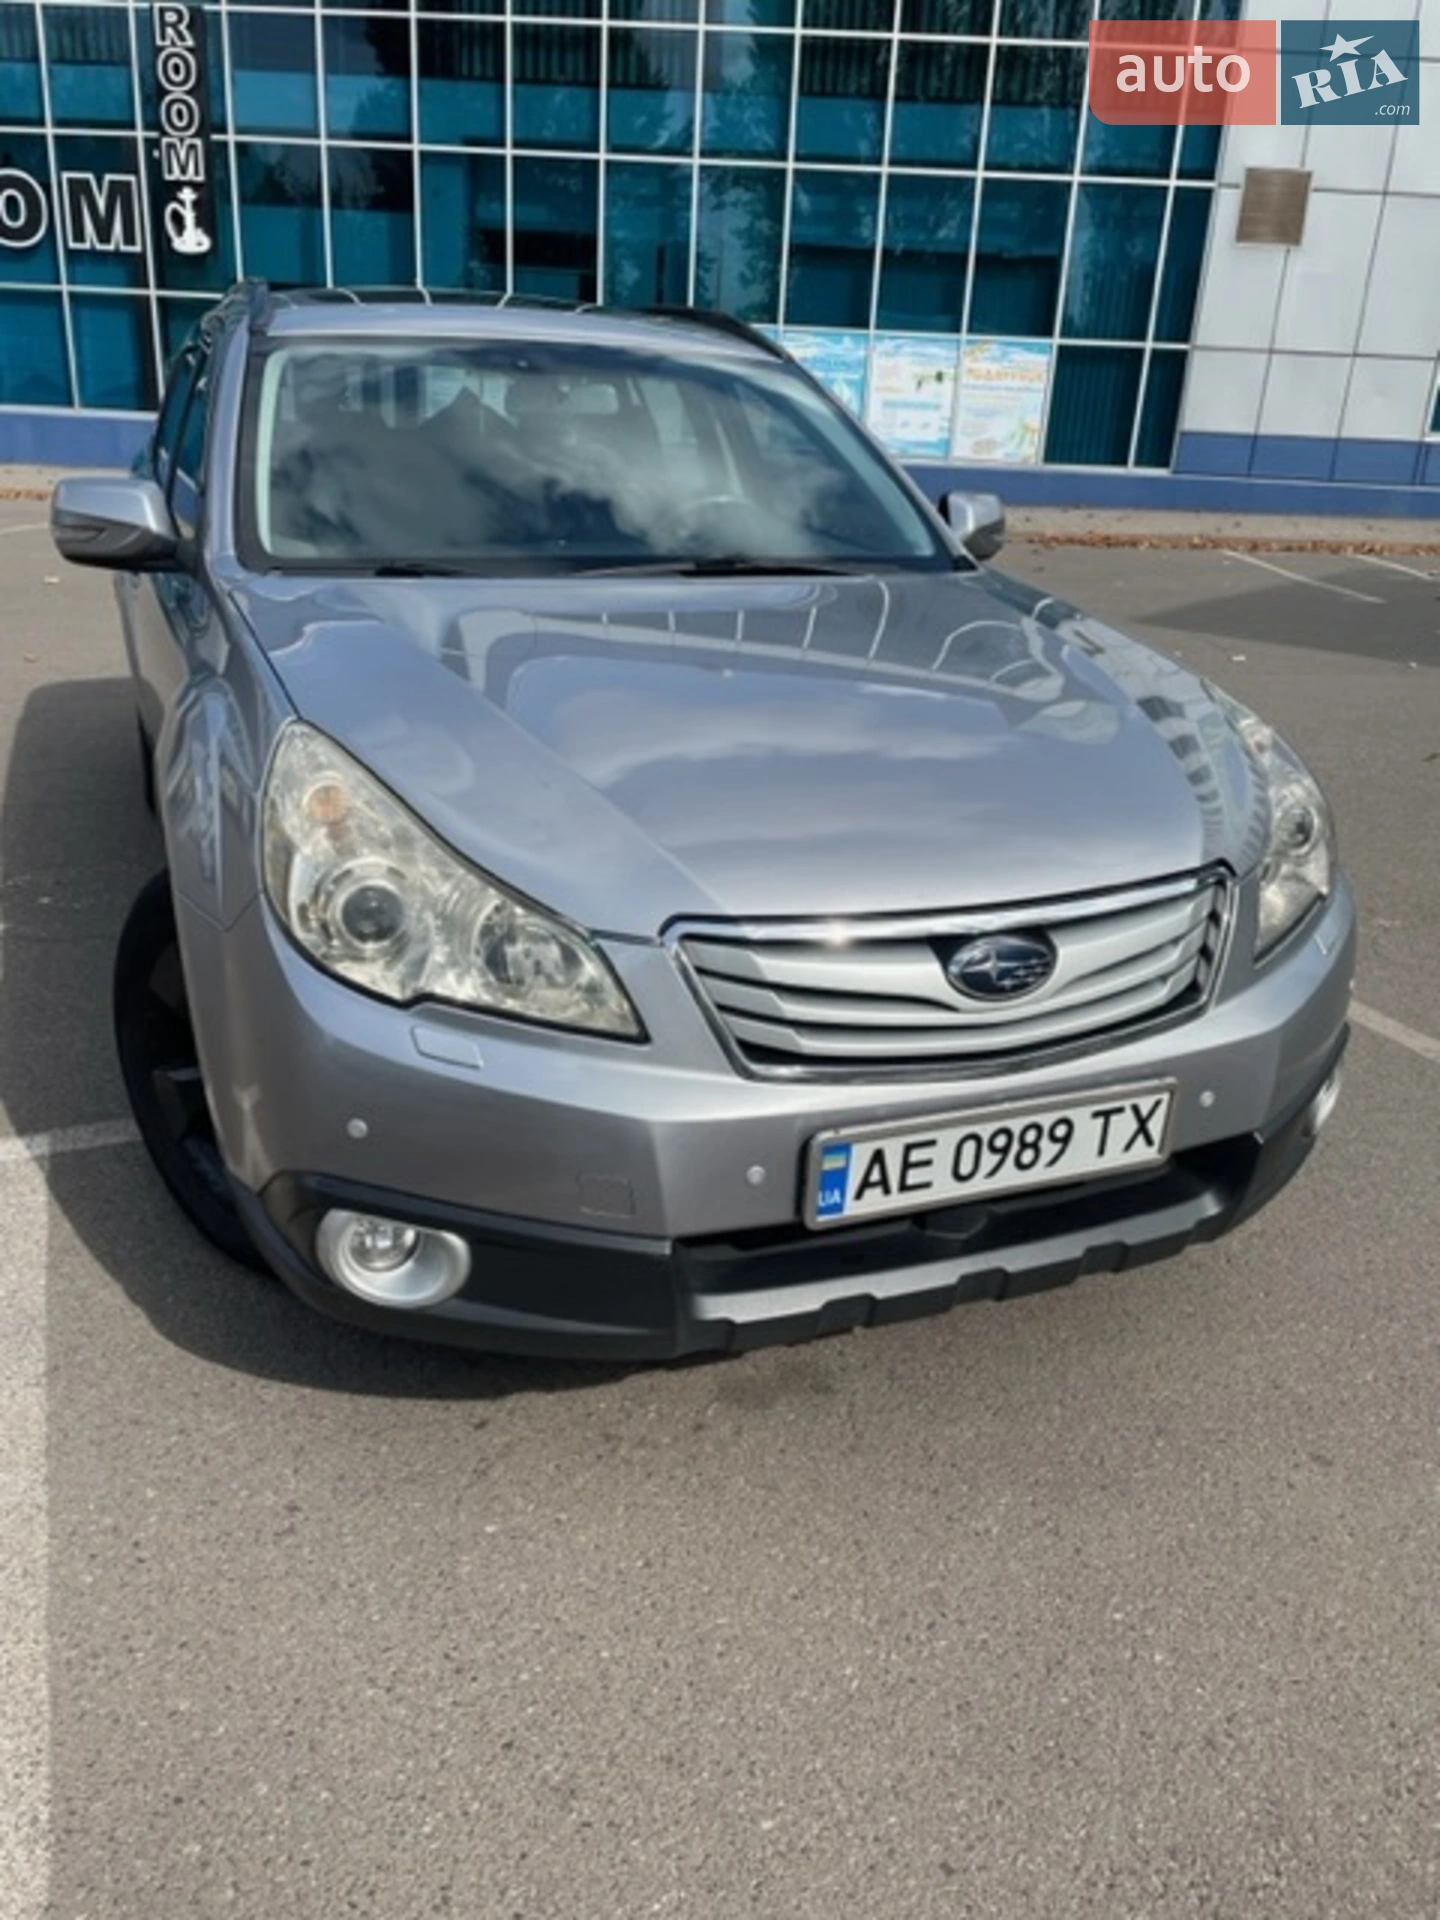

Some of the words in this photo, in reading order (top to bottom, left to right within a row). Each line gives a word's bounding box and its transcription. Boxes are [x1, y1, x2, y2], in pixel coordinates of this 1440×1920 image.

[153, 2, 205, 182] ROOM
[817, 1187, 842, 1207] UA
[854, 1138, 938, 1201] AE
[951, 1116, 1074, 1184] 0989
[1091, 1098, 1164, 1158] TX
